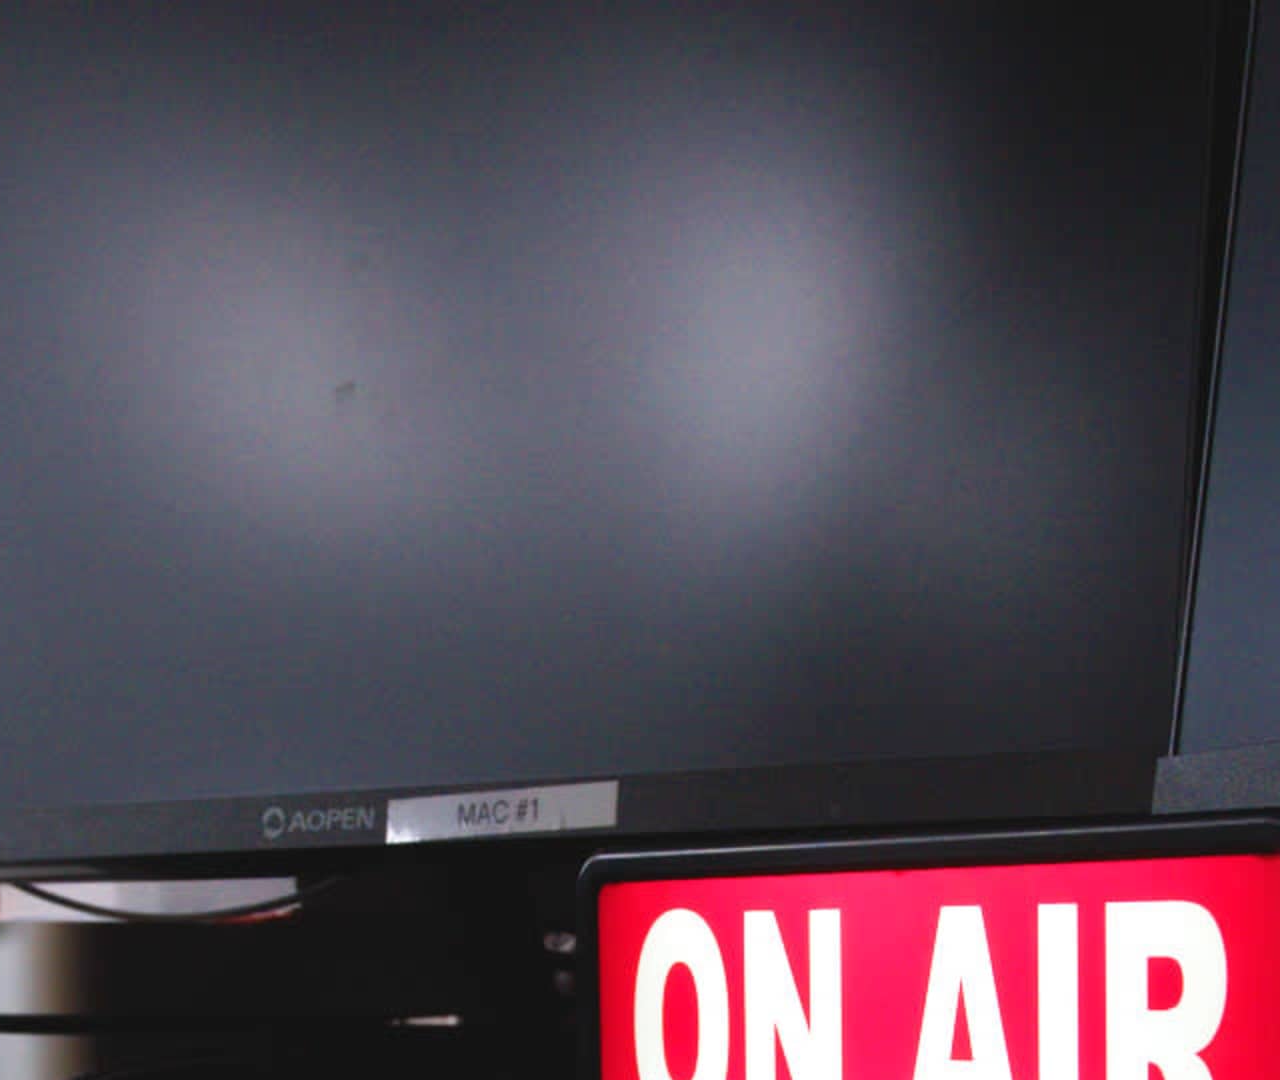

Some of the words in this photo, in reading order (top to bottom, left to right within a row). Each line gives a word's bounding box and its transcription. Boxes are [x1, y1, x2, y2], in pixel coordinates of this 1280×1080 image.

[288, 807, 375, 832] AOPEN
[457, 801, 509, 826] MAC
[516, 798, 540, 822] #1
